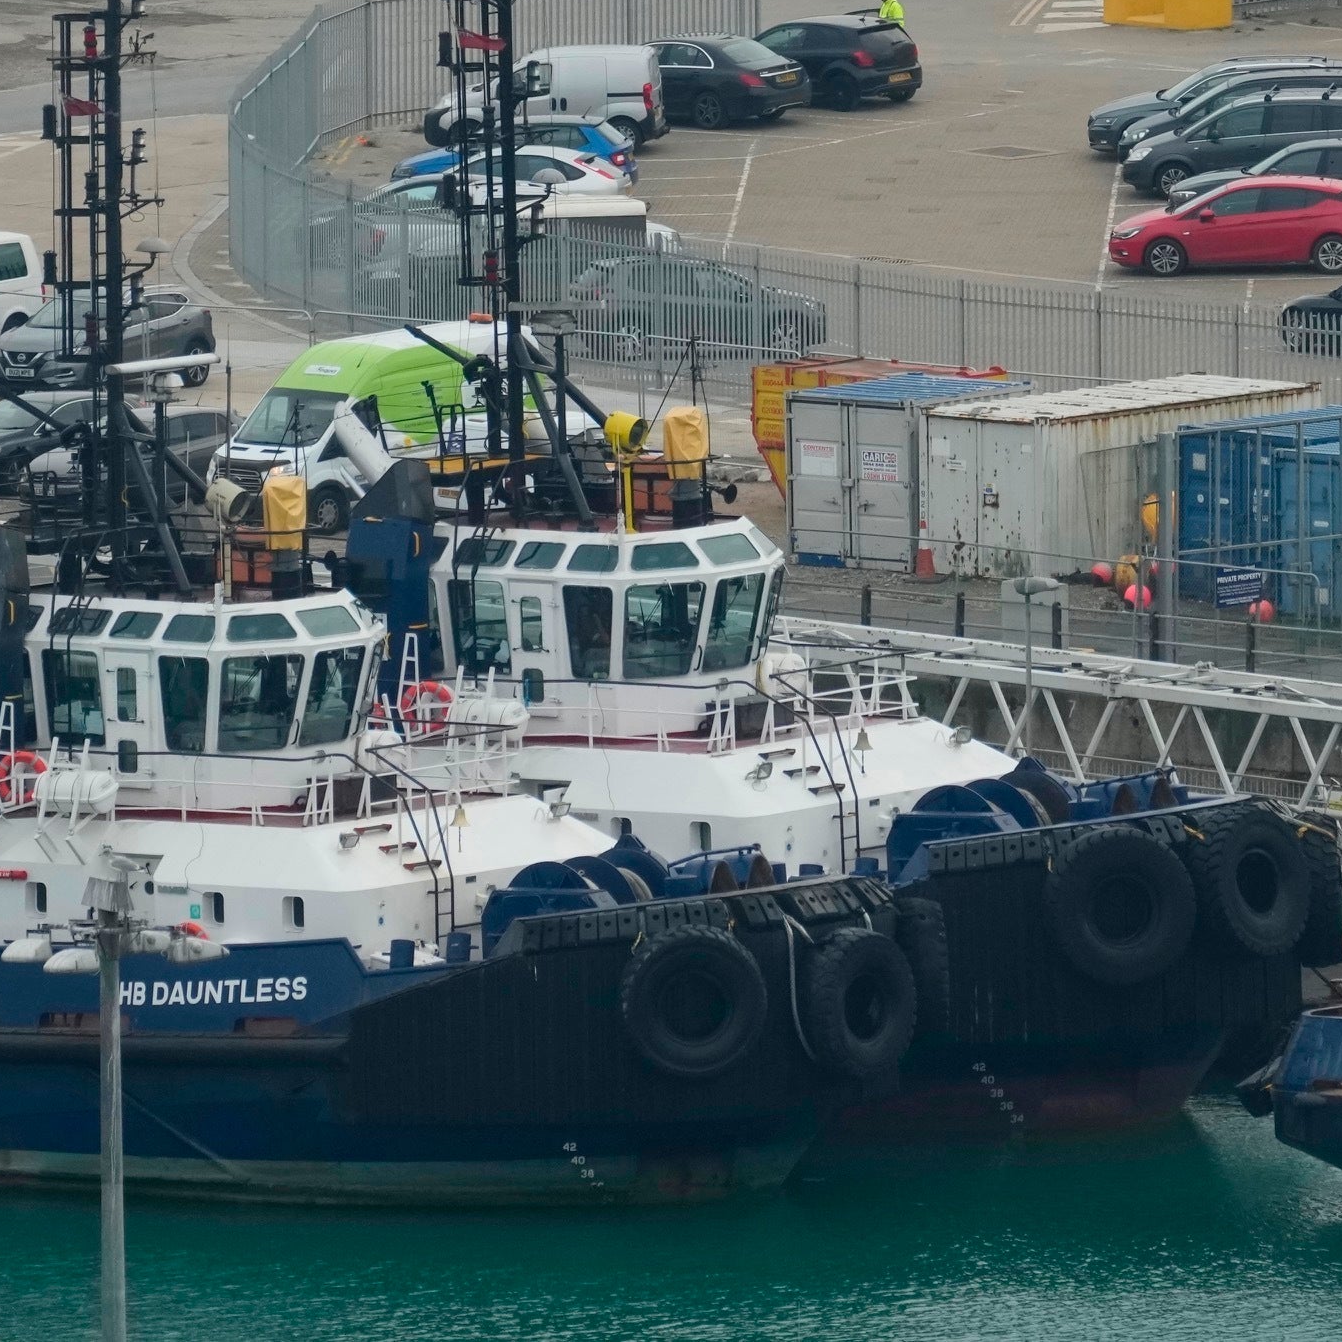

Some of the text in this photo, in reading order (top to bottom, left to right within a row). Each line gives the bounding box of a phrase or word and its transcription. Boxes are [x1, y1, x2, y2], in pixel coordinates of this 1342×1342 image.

[1217, 572, 1262, 584] PRIVATE PROPERTY
[119, 976, 308, 1006] HB DAUNTLESS
[972, 1062, 986, 1072] 42
[980, 1075, 995, 1085] 40
[990, 1088, 1004, 1098] 38
[999, 1101, 1014, 1111] 36
[1010, 1114, 1024, 1124] 34
[562, 1142, 577, 1152] 42
[570, 1156, 586, 1166] 40
[580, 1169, 595, 1179] 38
